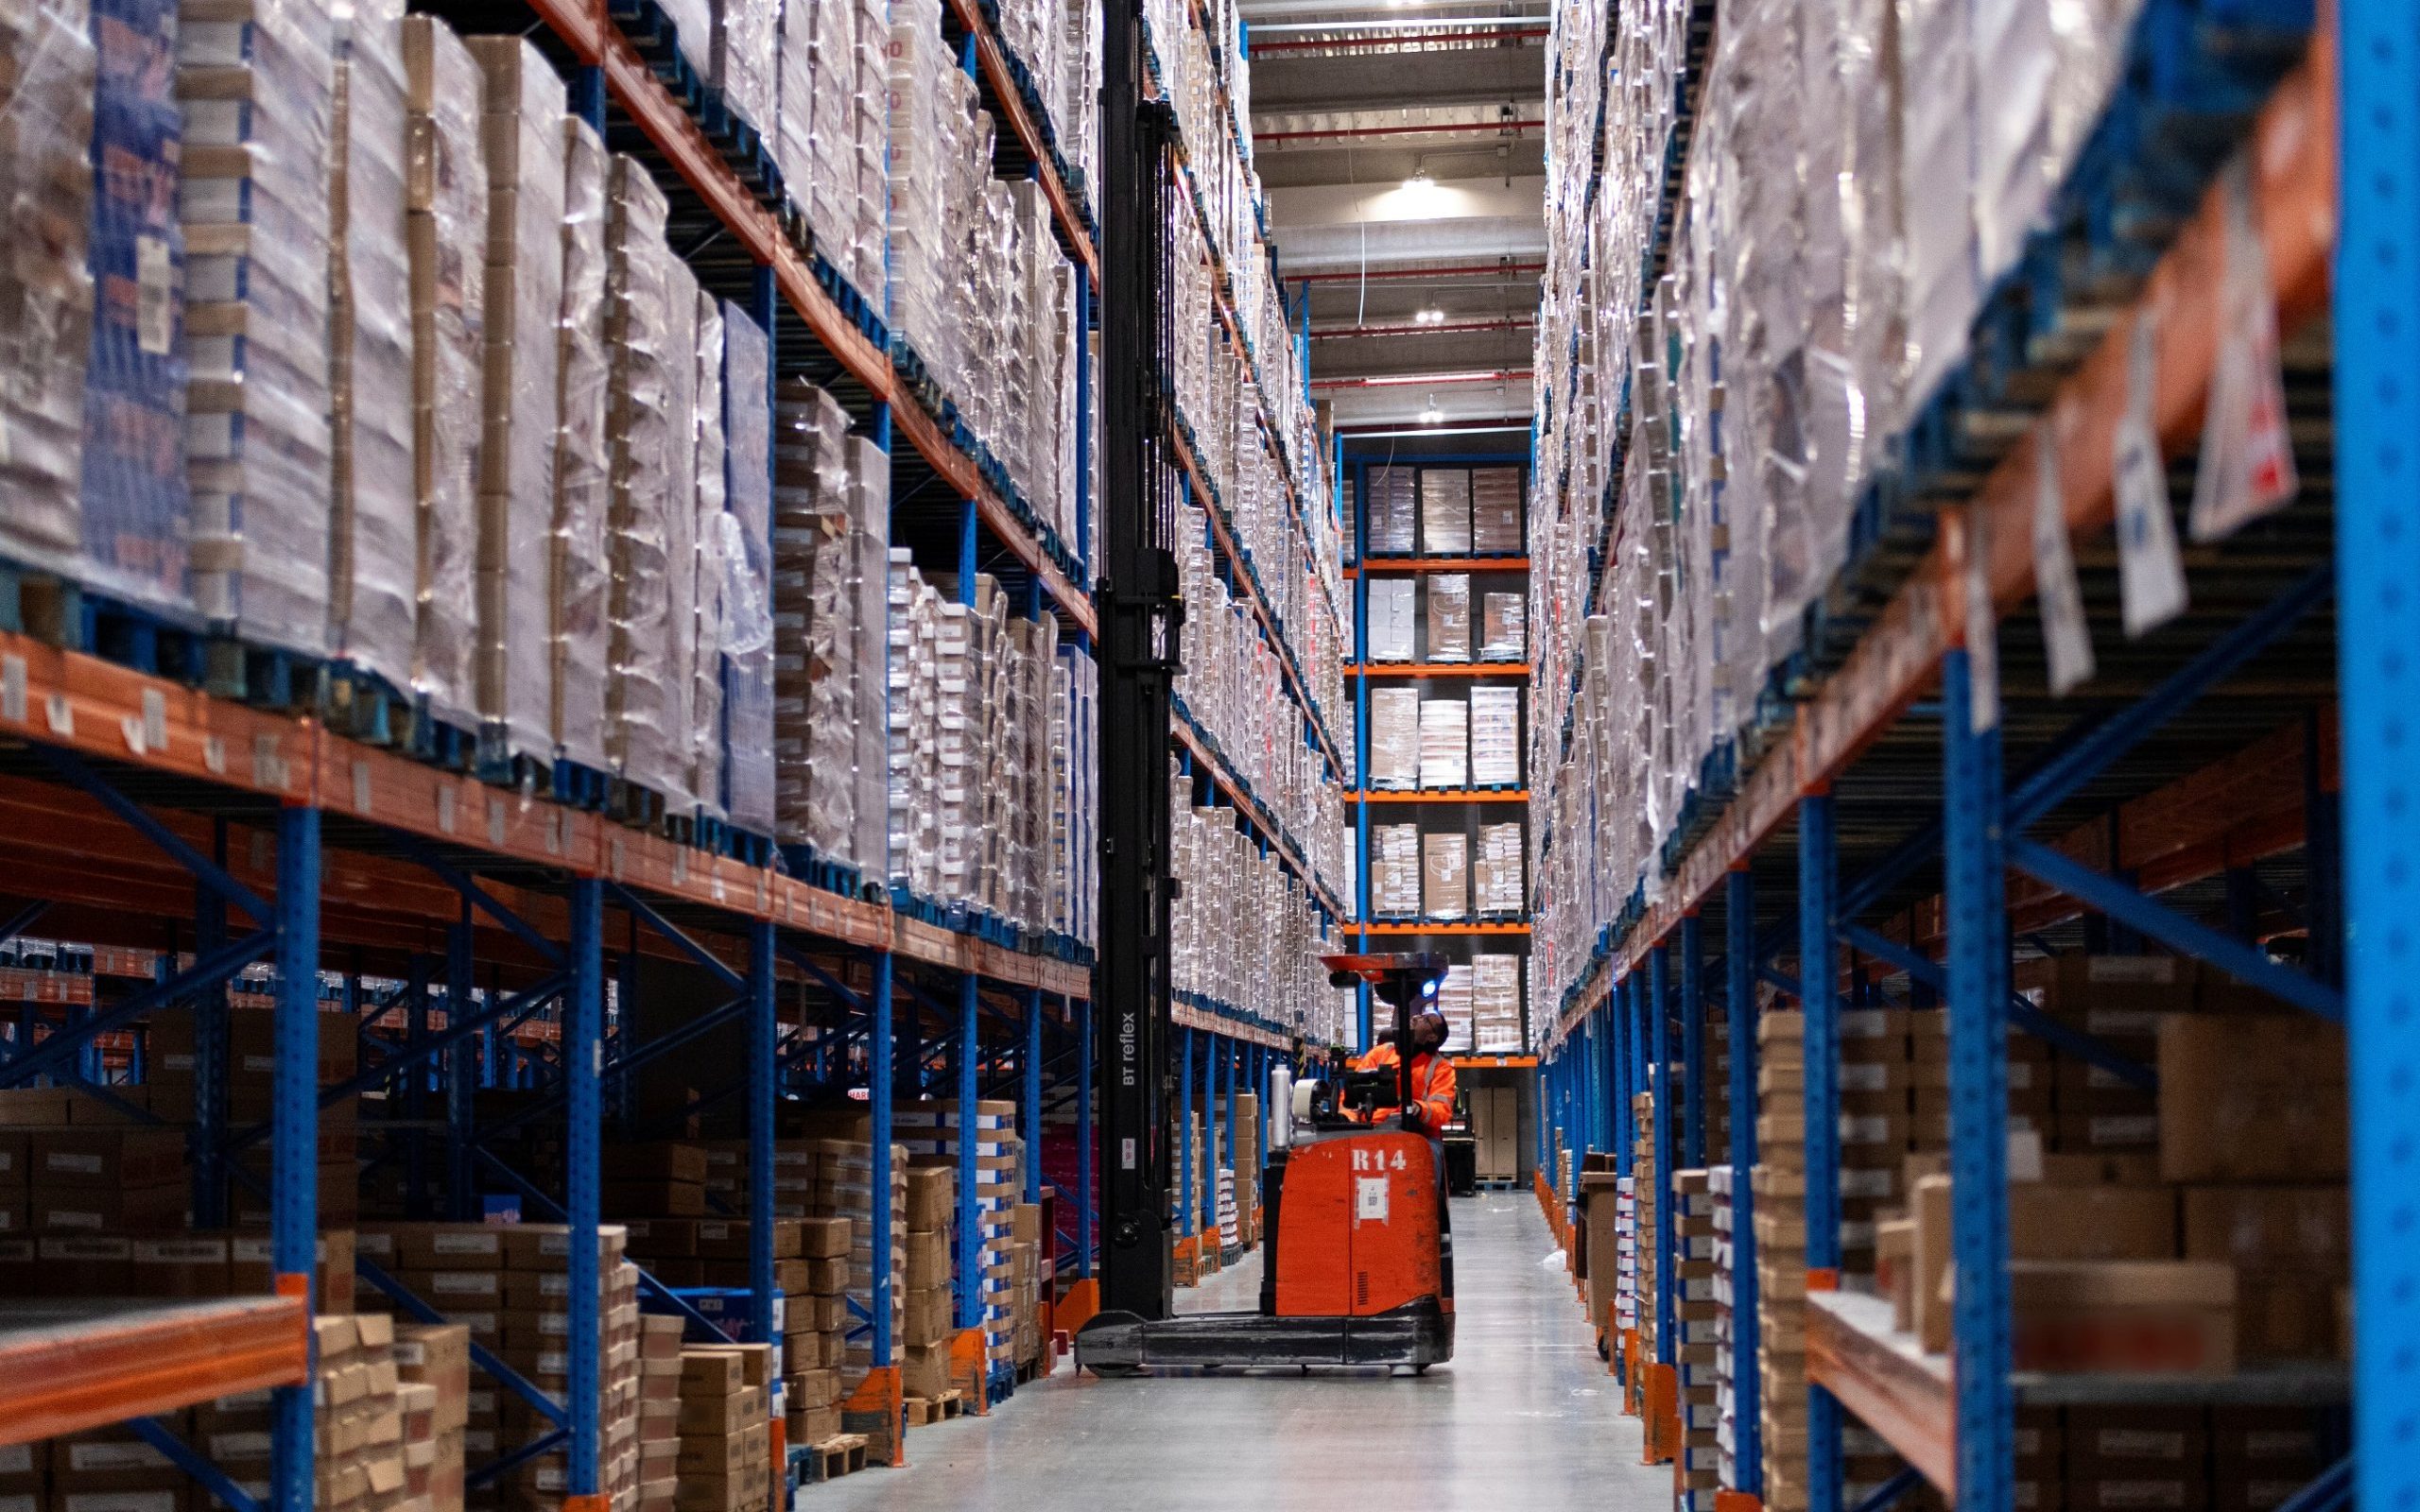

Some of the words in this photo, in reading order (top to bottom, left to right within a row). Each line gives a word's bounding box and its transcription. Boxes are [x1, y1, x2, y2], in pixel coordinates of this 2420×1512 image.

[1119, 1013, 1134, 1060] reflex
[1123, 1067, 1134, 1085] BT
[849, 1091, 869, 1100] HAR
[1352, 1149, 1407, 1170] R14
